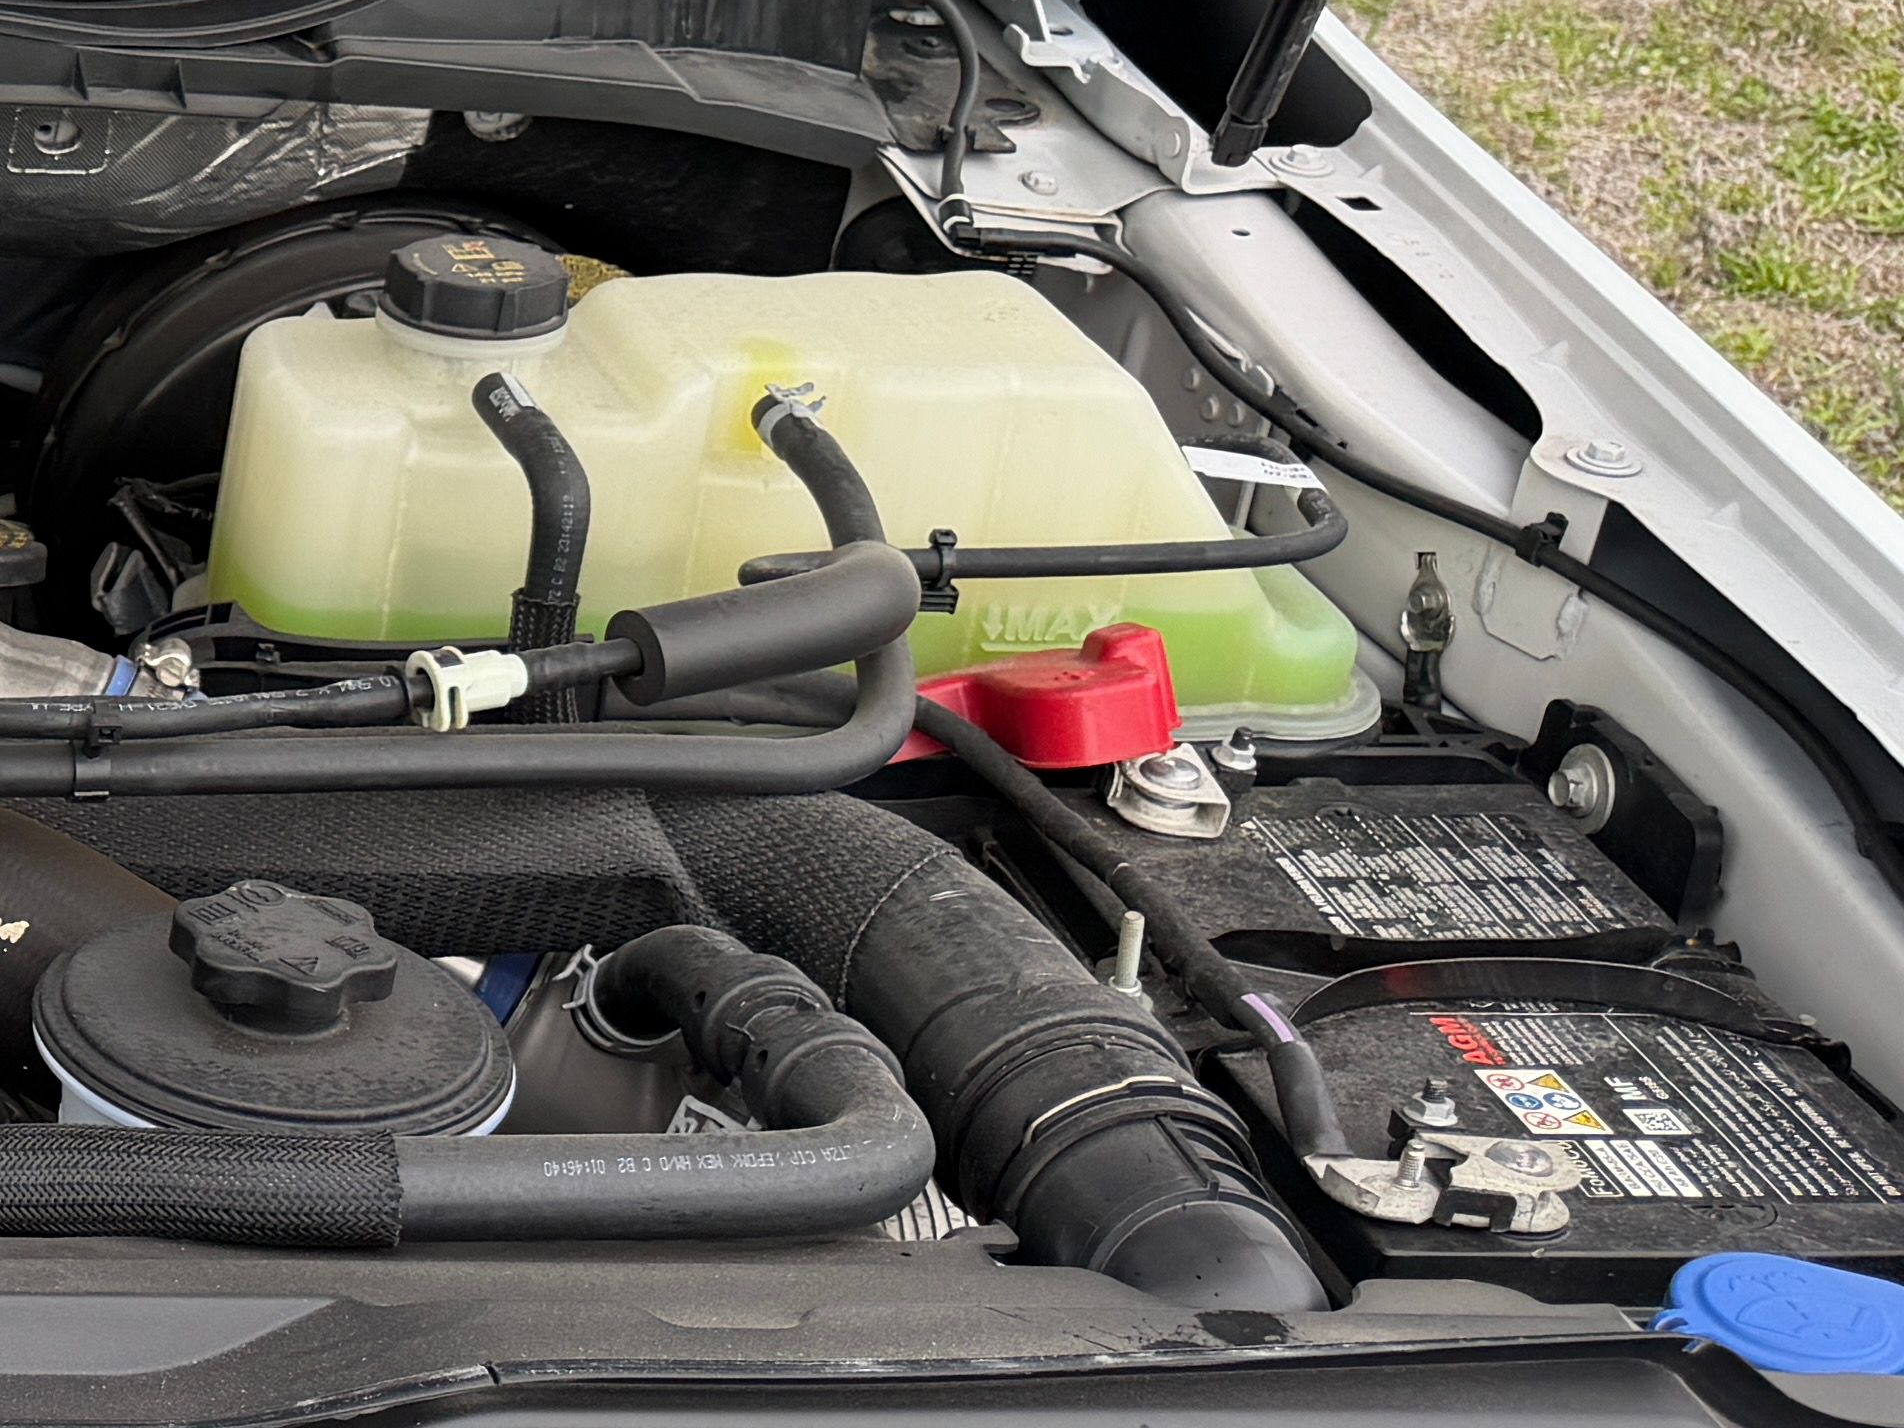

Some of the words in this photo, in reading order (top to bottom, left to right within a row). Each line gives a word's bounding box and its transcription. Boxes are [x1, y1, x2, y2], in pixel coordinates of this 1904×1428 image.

[1004, 601, 1125, 641] MAX
[1430, 1018, 1488, 1064] AGM
[1604, 1076, 1647, 1100] MF
[542, 1155, 605, 1177] 01:46:40
